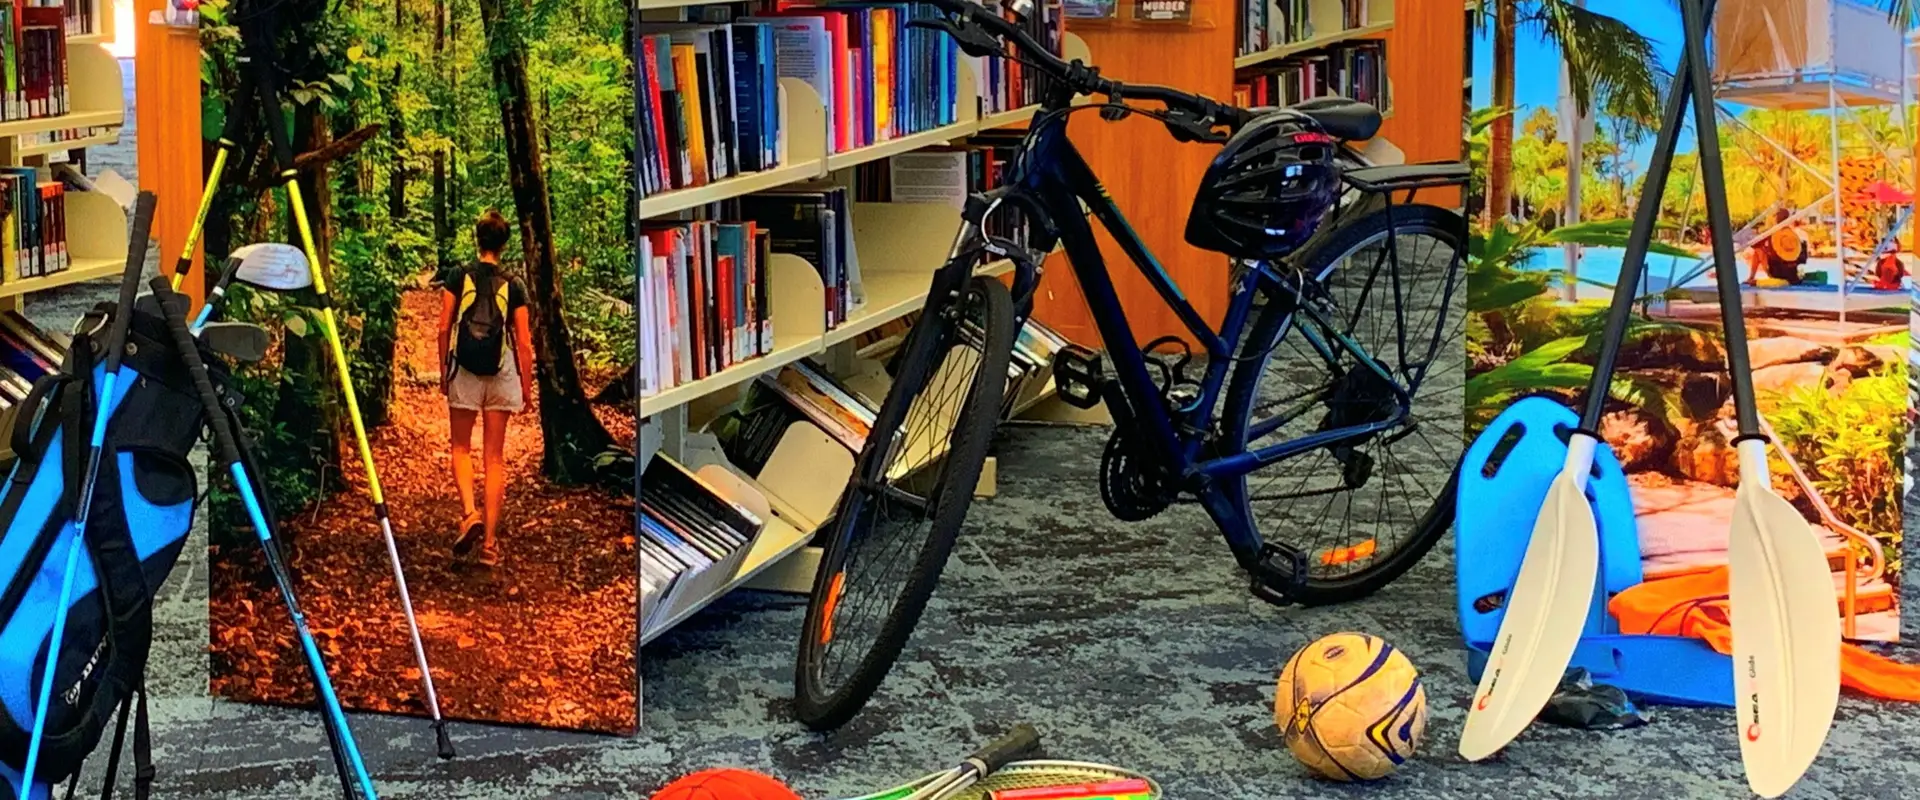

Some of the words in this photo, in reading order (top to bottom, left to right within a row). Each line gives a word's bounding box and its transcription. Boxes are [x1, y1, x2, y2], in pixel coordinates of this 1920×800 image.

[1142, 1, 1185, 11] MURDER
[1748, 655, 1756, 678] Glide
[1751, 693, 1759, 724] SEA
